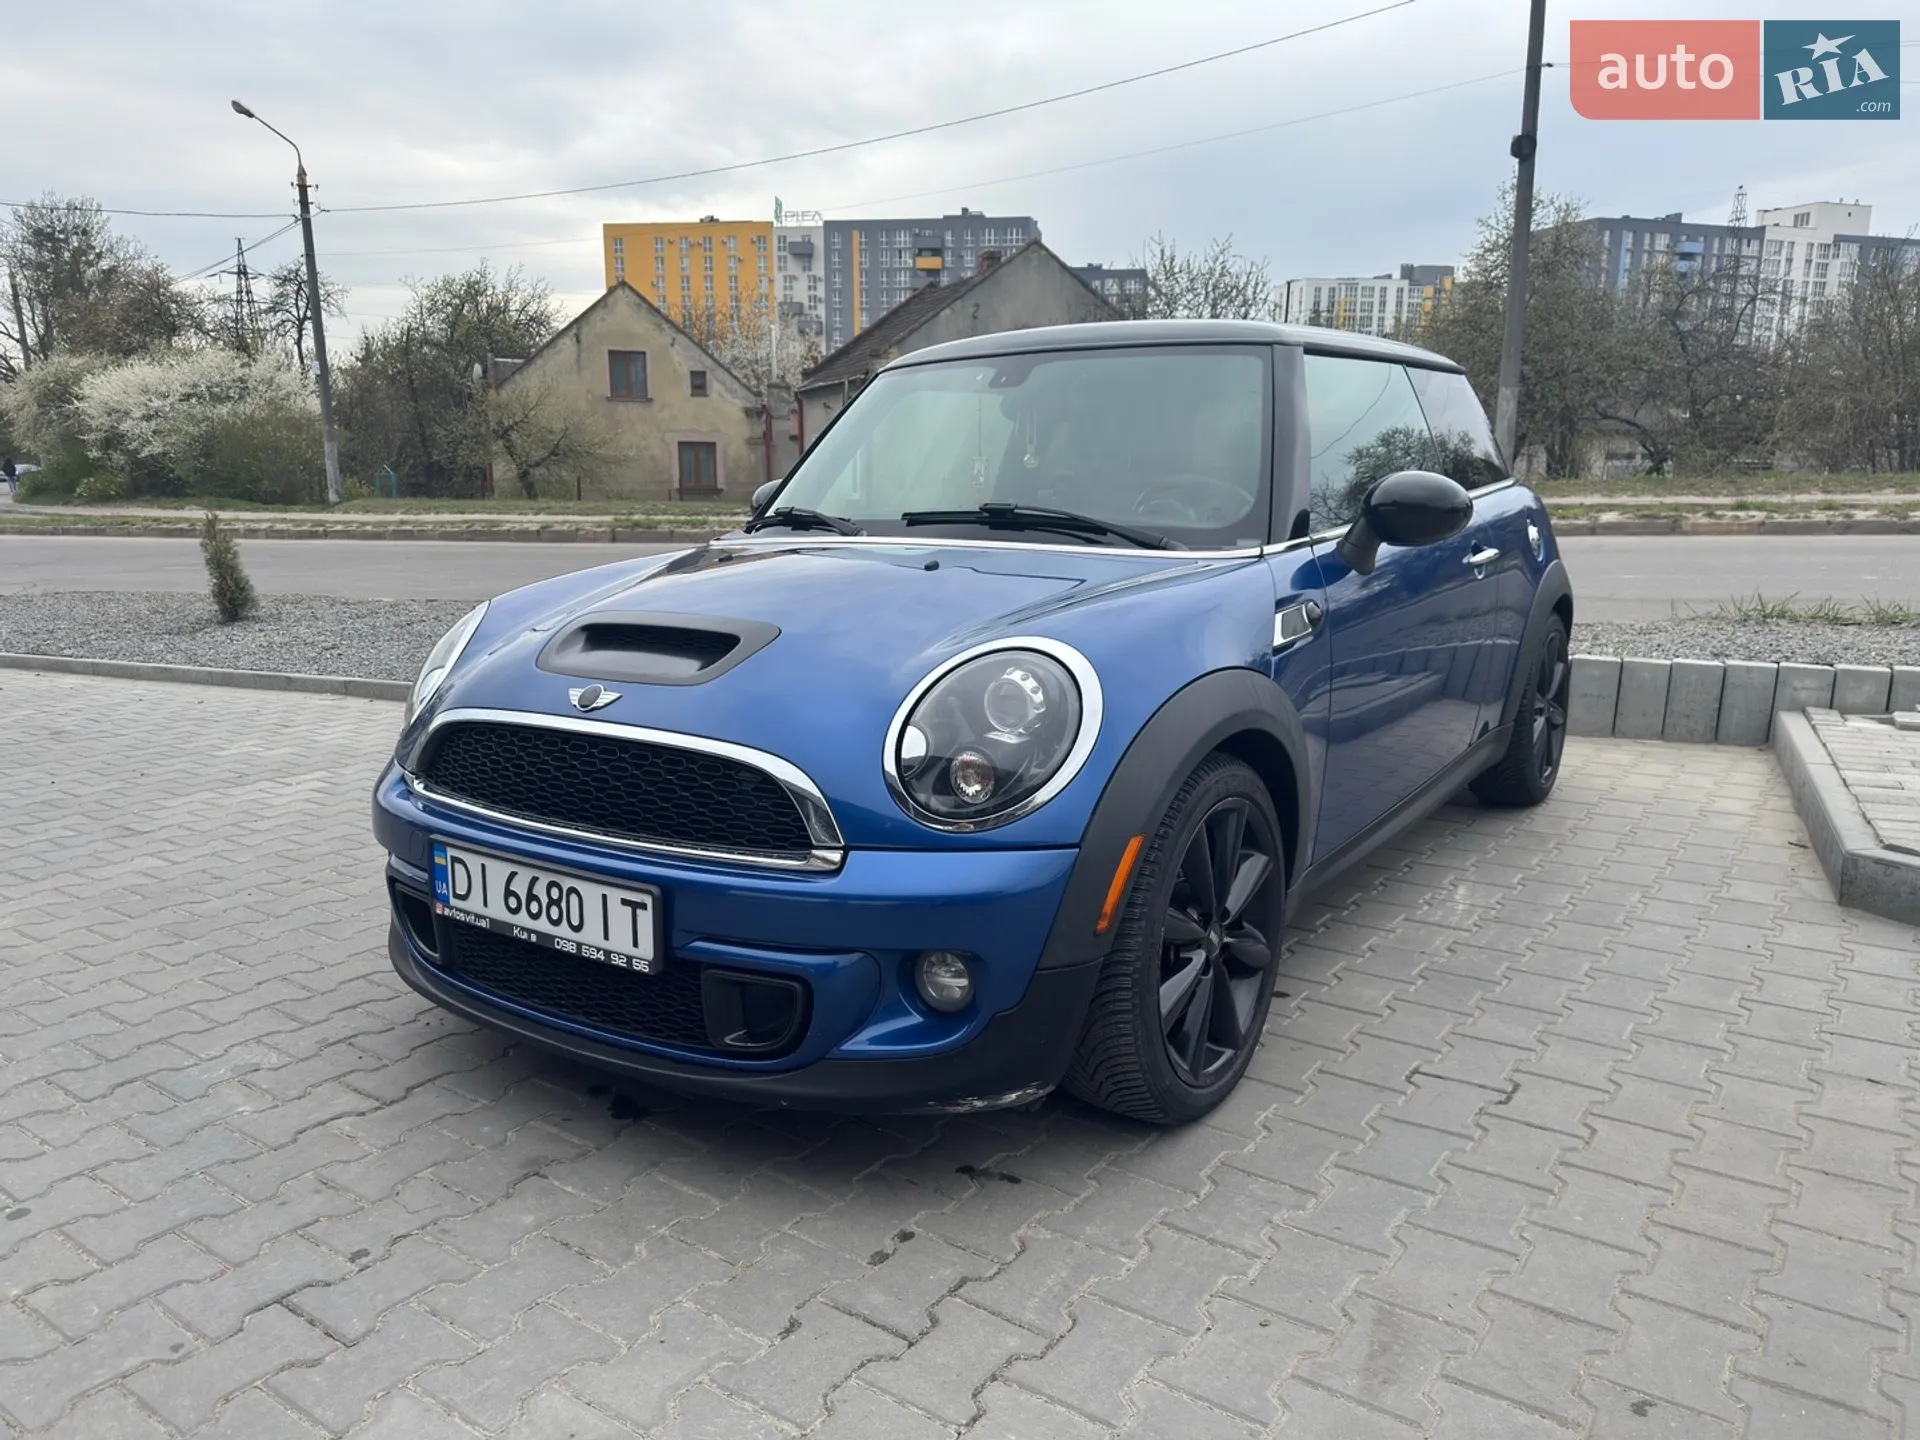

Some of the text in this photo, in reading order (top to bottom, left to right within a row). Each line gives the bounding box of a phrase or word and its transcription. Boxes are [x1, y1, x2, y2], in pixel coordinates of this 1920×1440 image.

[435, 880, 448, 896] UA
[450, 855, 648, 949] DI 6680 IT
[554, 938, 650, 972] 098 594 92 55
